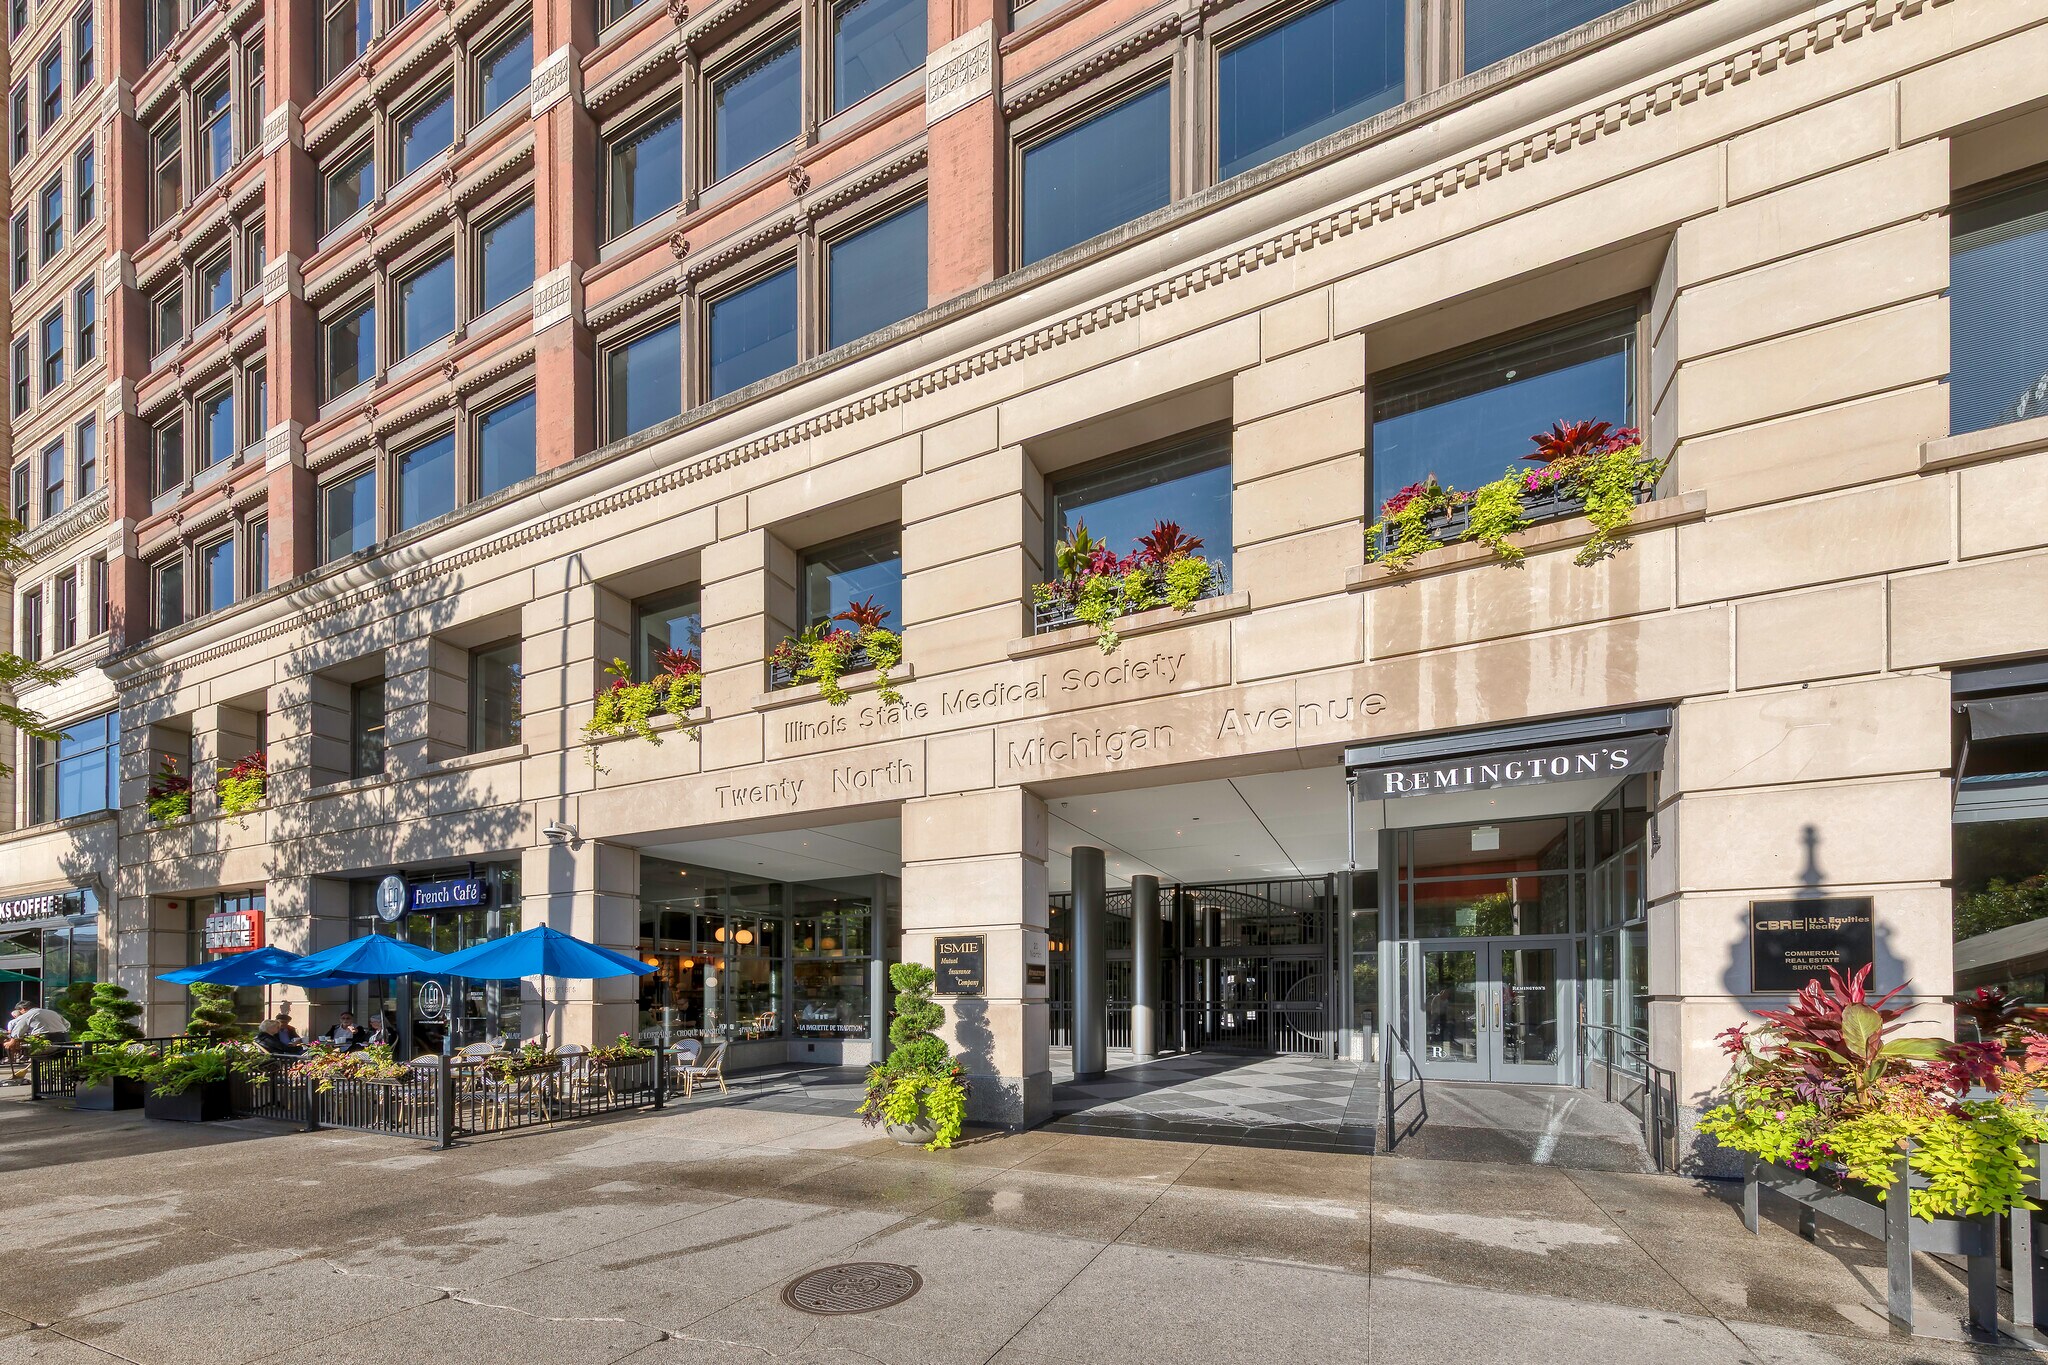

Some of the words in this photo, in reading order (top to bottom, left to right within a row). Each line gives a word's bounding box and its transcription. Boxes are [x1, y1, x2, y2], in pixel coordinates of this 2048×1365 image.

[785, 713, 848, 744] Illinois
[859, 698, 929, 728] State
[942, 673, 1048, 716] Medical
[1061, 651, 1187, 693] Society
[715, 777, 804, 808] Twenty
[832, 759, 913, 793] North
[1007, 724, 1176, 769] Michigan
[1217, 691, 1388, 741] Avenue
[1383, 748, 1630, 795] REMINGTON'S
[415, 886, 449, 905] French
[453, 883, 478, 901] Café
[14, 895, 54, 917] COFFEE
[1755, 920, 1804, 931] CBRE
[1829, 915, 1870, 925] Equities
[1809, 923, 1841, 931] Realty
[940, 942, 979, 954] ISMIE
[940, 957, 959, 965] Mutual
[957, 978, 979, 988] Company
[677, 1028, 699, 1038] CROQUE
